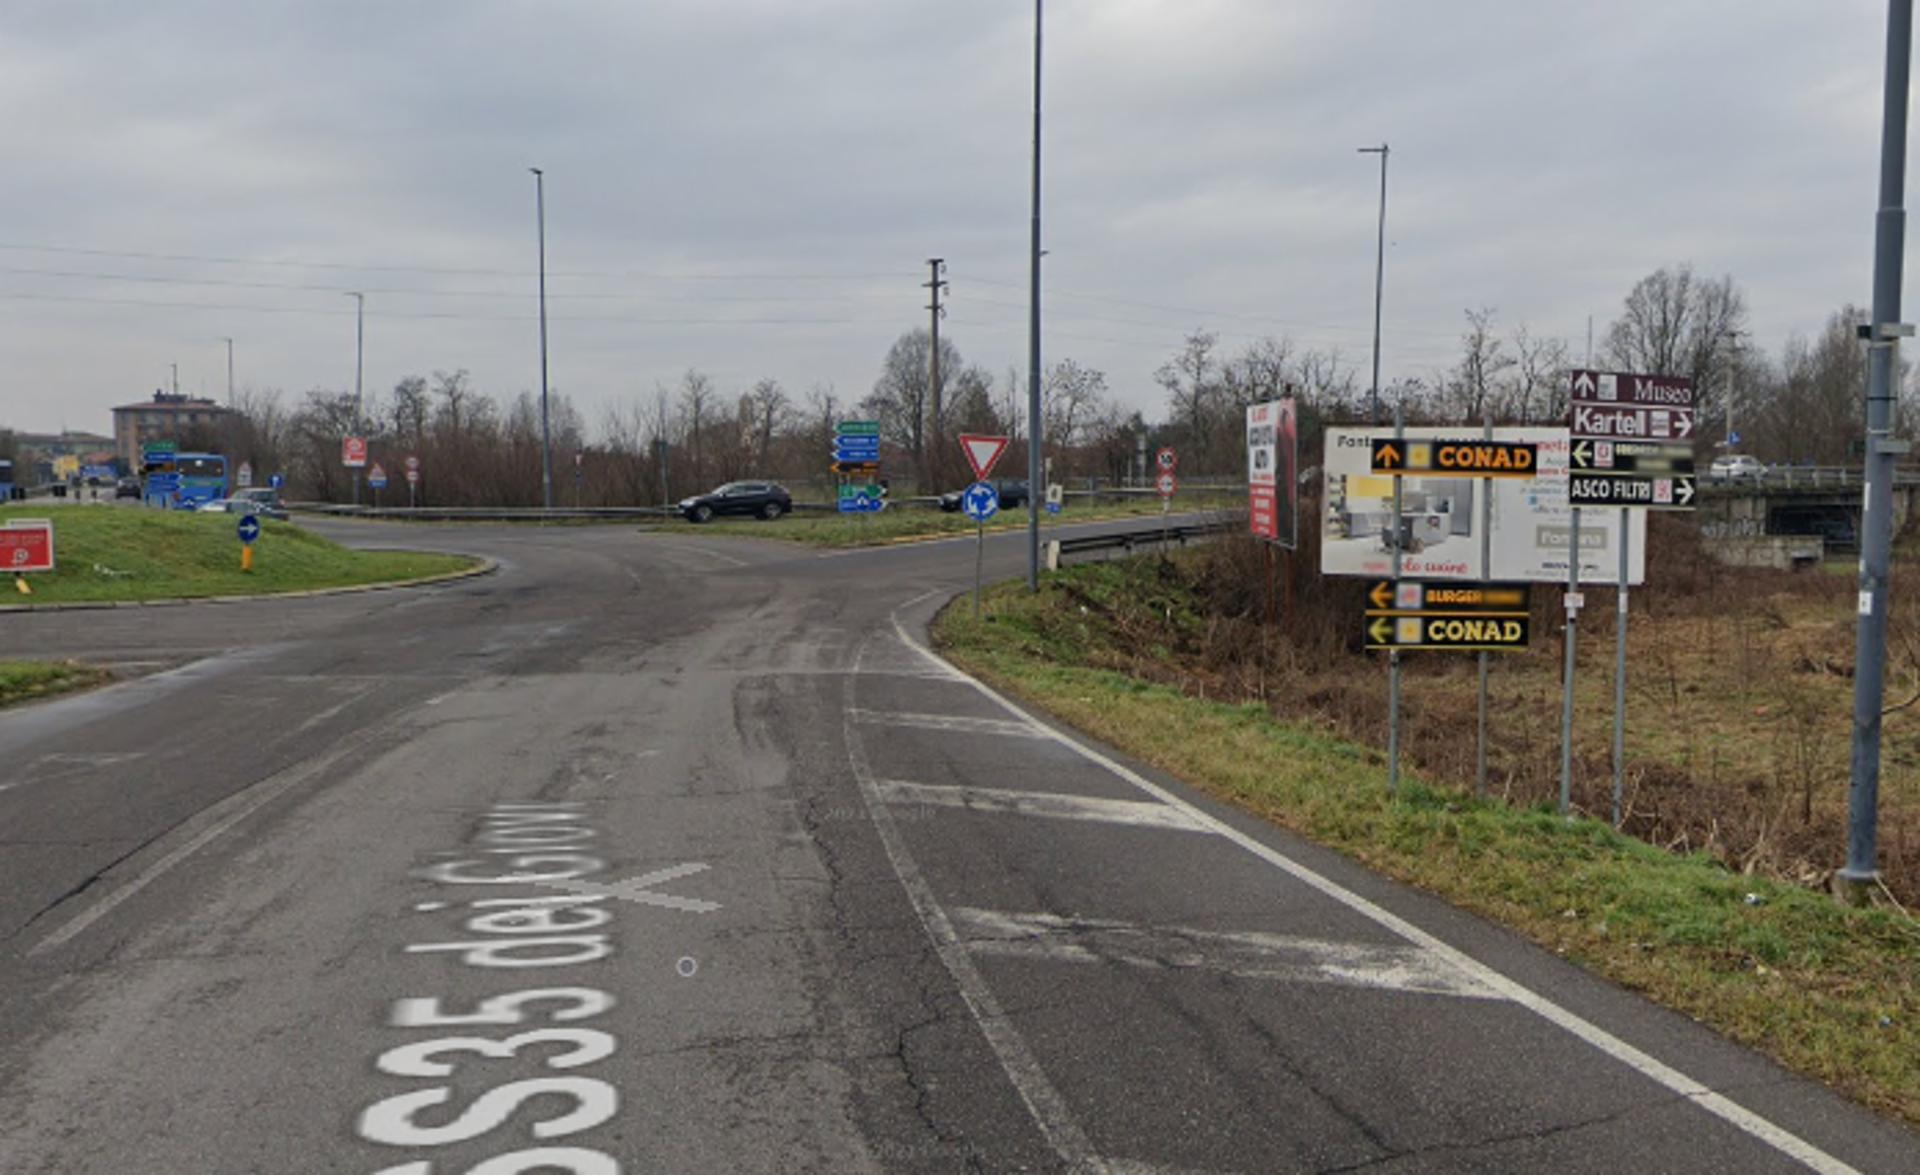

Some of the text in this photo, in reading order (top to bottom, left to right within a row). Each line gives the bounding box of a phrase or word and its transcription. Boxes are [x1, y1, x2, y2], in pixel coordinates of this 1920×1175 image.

[1633, 378, 1692, 404] Museo
[1574, 407, 1646, 435] Kartell
[1438, 446, 1532, 469] CONAD
[1571, 479, 1611, 498] ASCO
[1613, 480, 1651, 499] FILTRI
[1426, 589, 1484, 604] BURGER
[1428, 619, 1522, 642] CONAD
